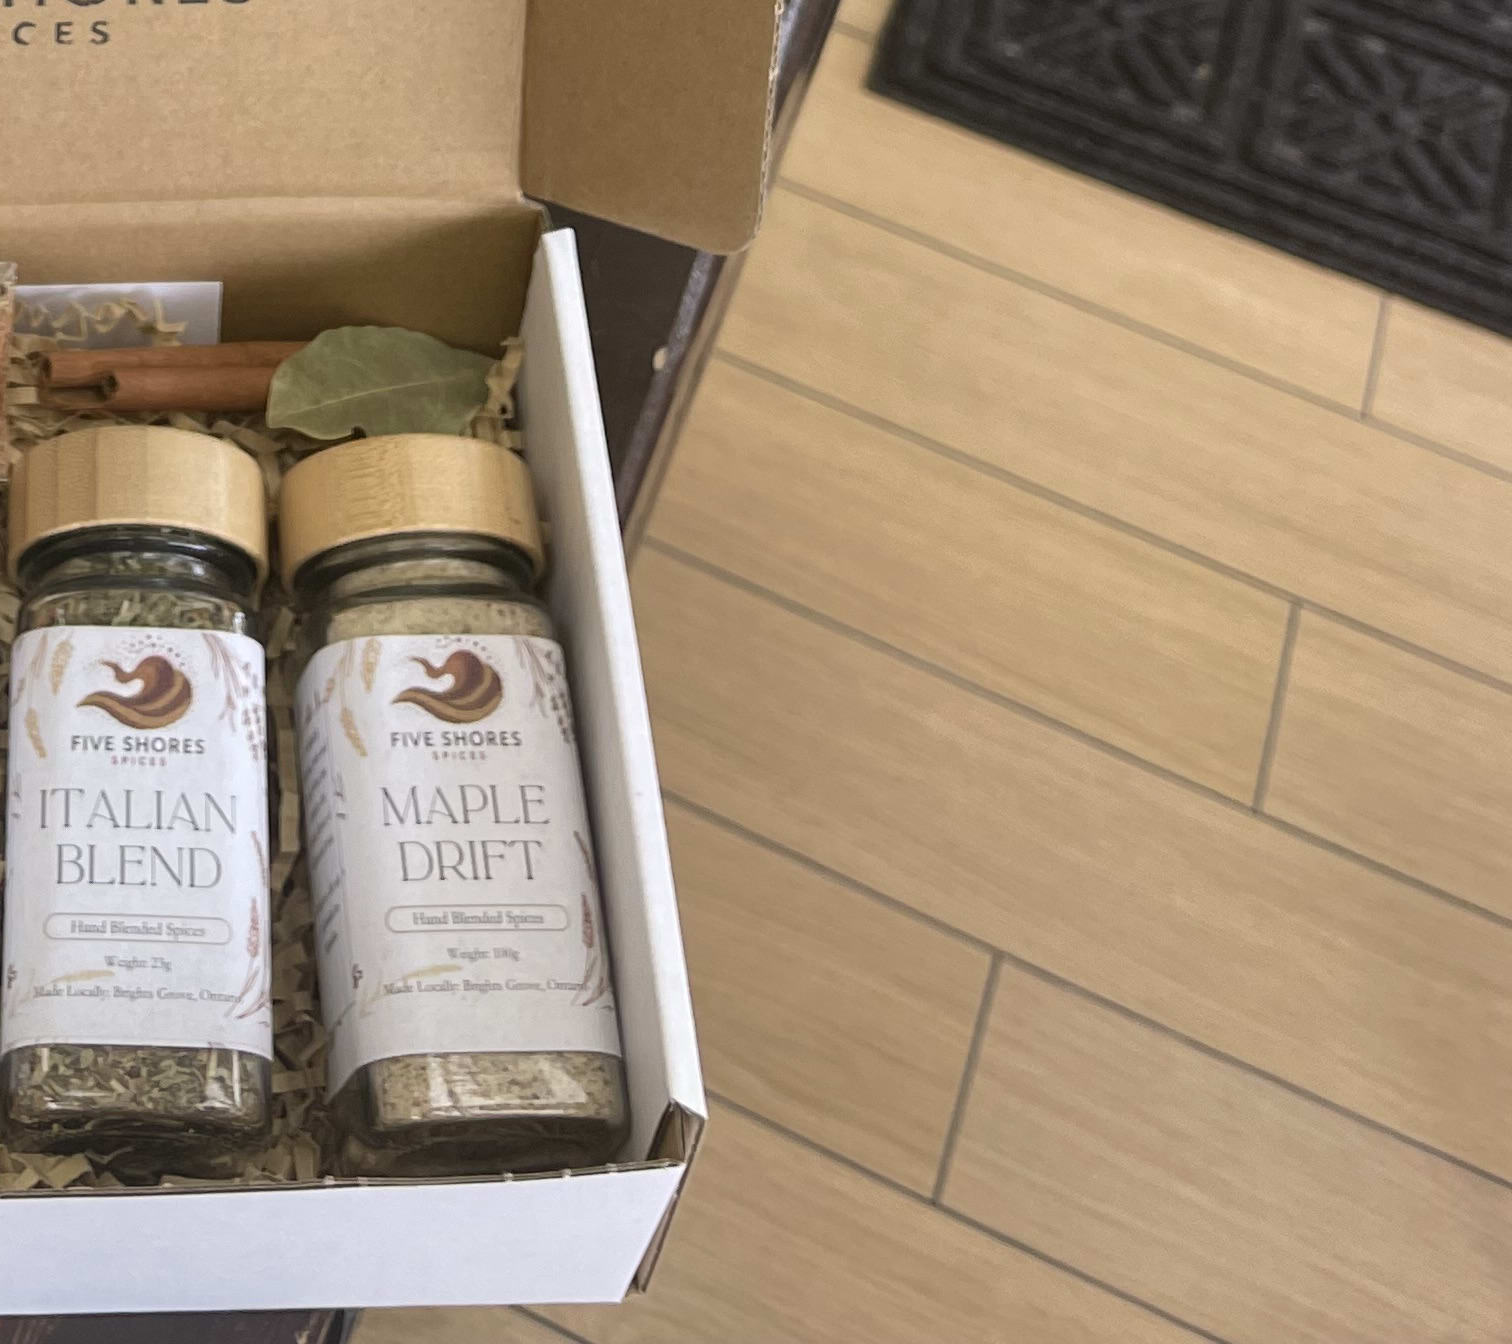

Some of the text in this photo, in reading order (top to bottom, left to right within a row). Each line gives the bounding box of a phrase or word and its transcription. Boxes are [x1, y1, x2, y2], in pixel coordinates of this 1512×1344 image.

[70, 734, 205, 755] FIVE SHORES
[390, 729, 522, 748] FIVE SHORES
[110, 755, 167, 767] SPICES
[432, 750, 488, 761] SPICES
[38, 787, 238, 835] ITALIAN
[381, 784, 550, 827] MAPLE
[55, 843, 223, 890] BLEND
[398, 839, 544, 882] DRIFT
[70, 919, 206, 941] Hand Blended Spices
[413, 911, 544, 928] Hand Blended Spices
